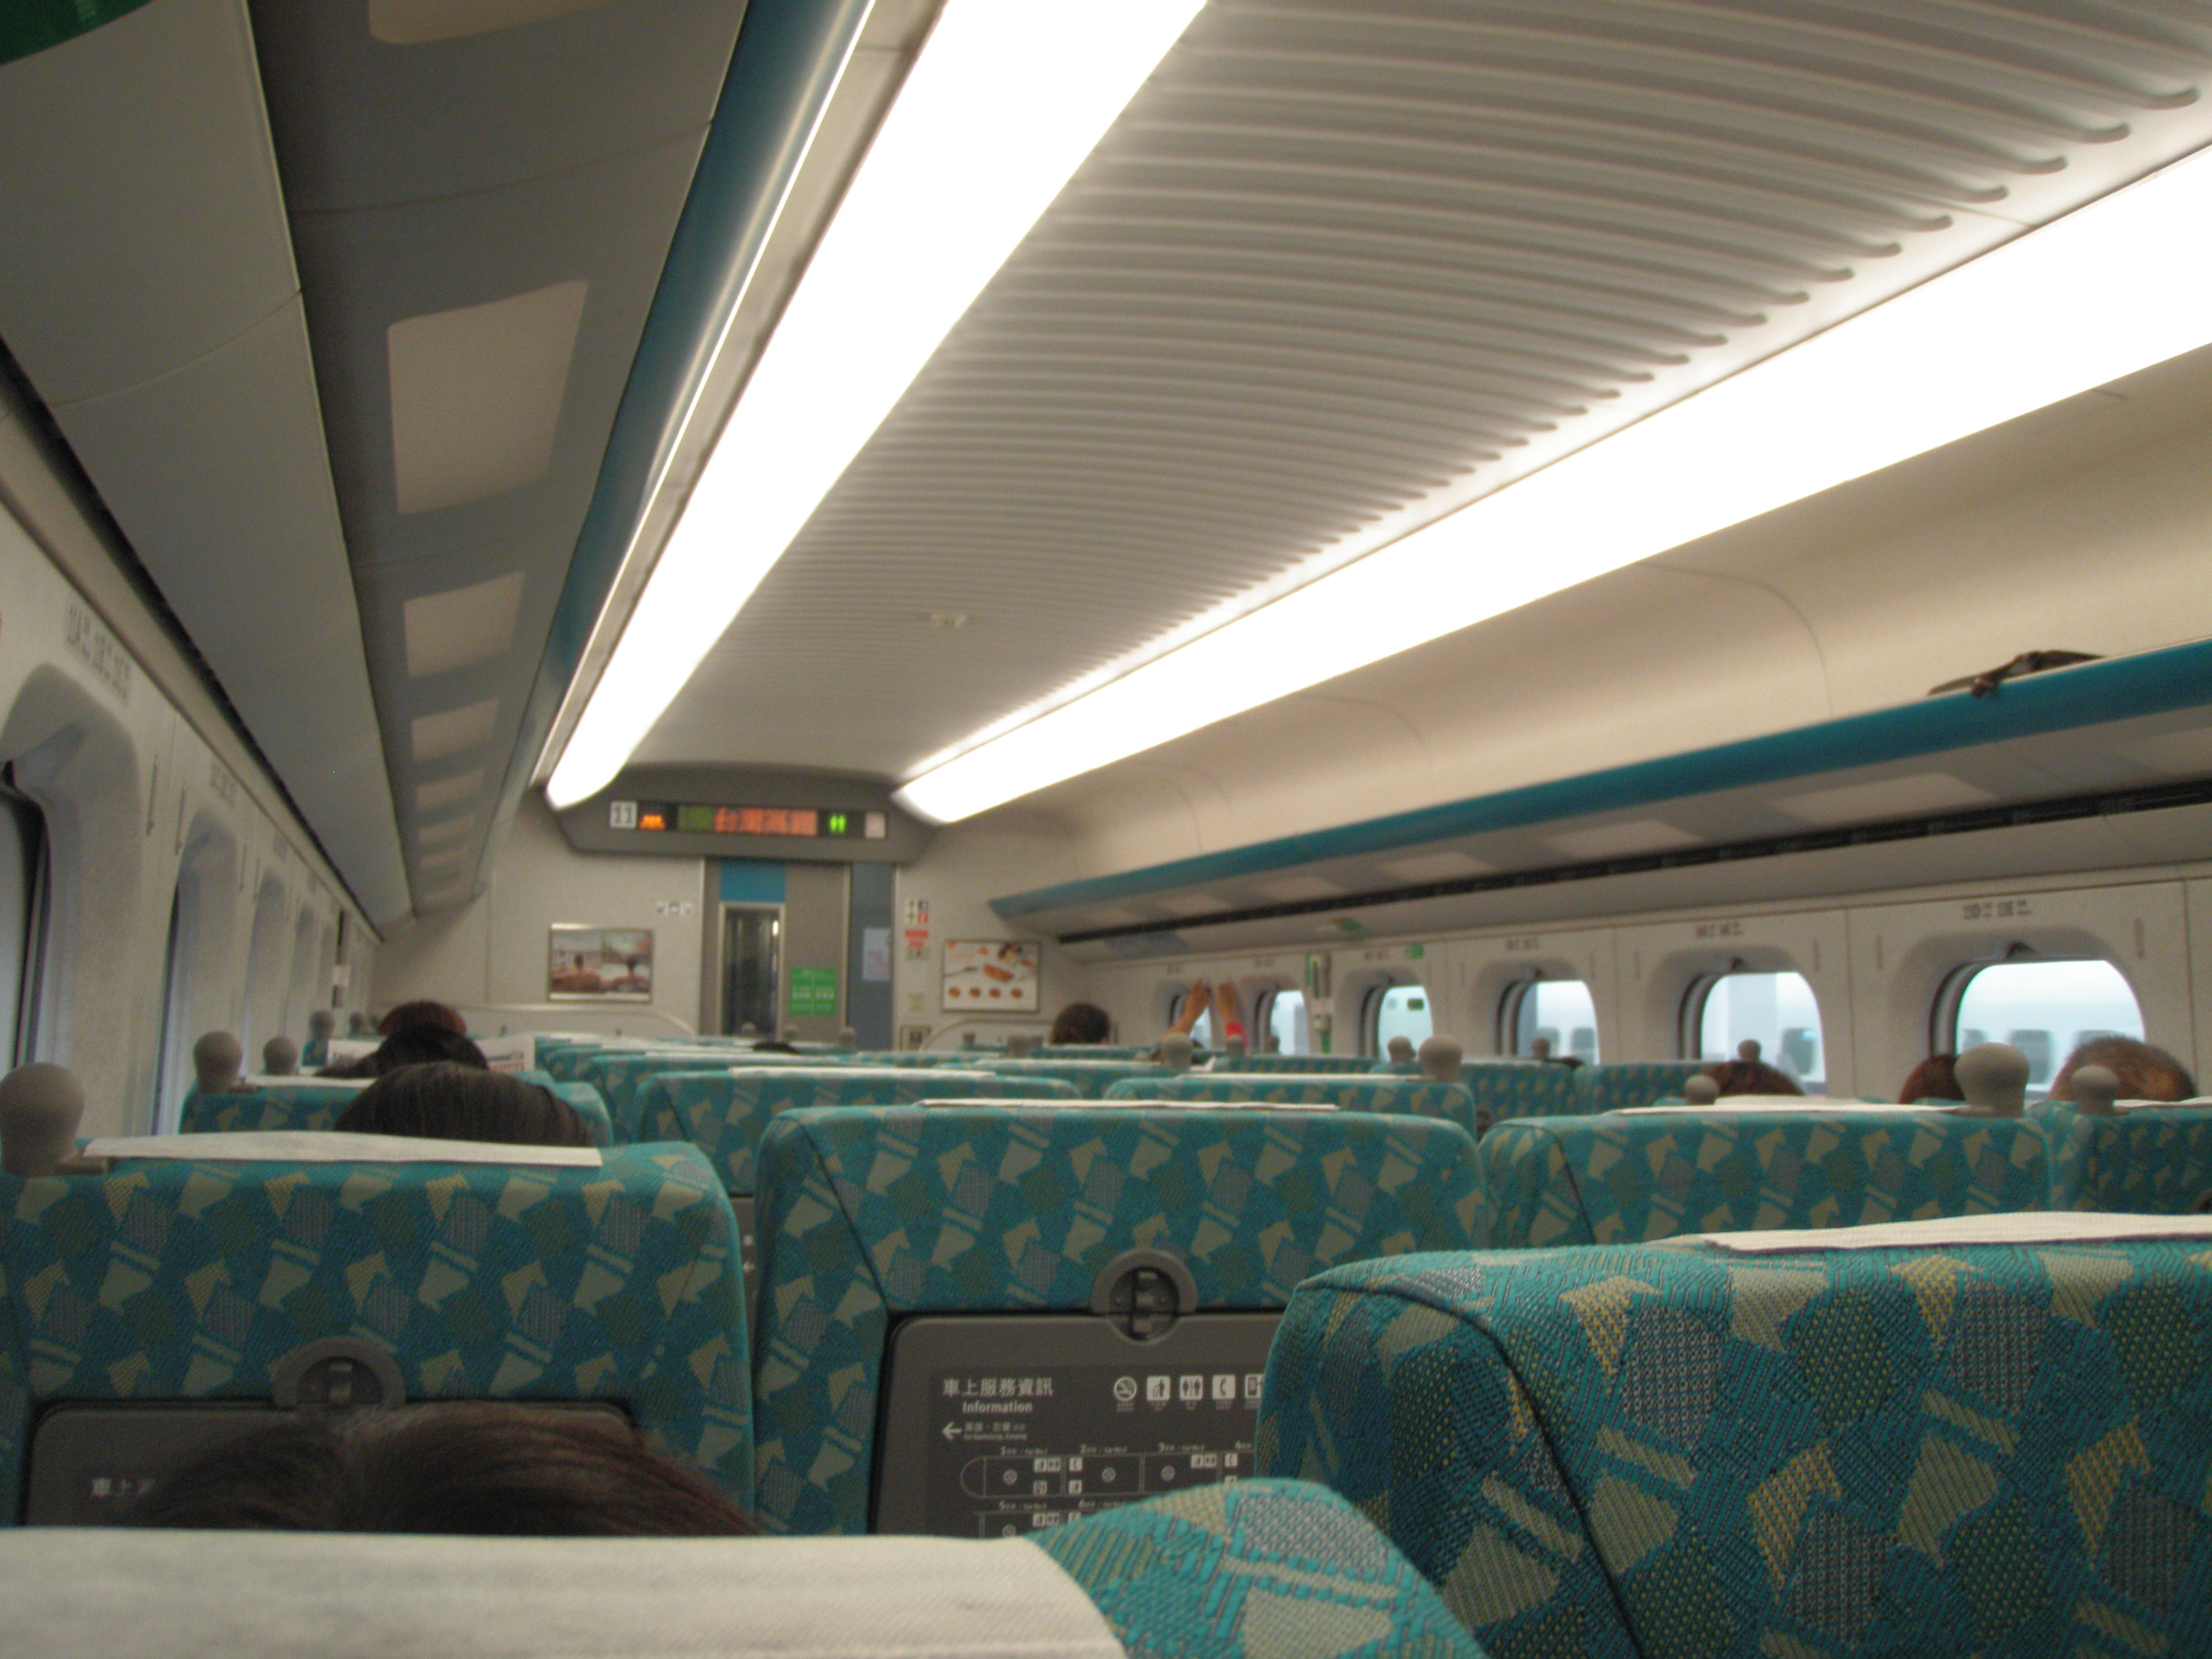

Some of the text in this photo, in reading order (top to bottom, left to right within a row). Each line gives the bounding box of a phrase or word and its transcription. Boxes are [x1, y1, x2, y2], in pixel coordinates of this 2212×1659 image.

[942, 1378, 1054, 1397] 車上服務資訊
[962, 1401, 1033, 1414] Information
